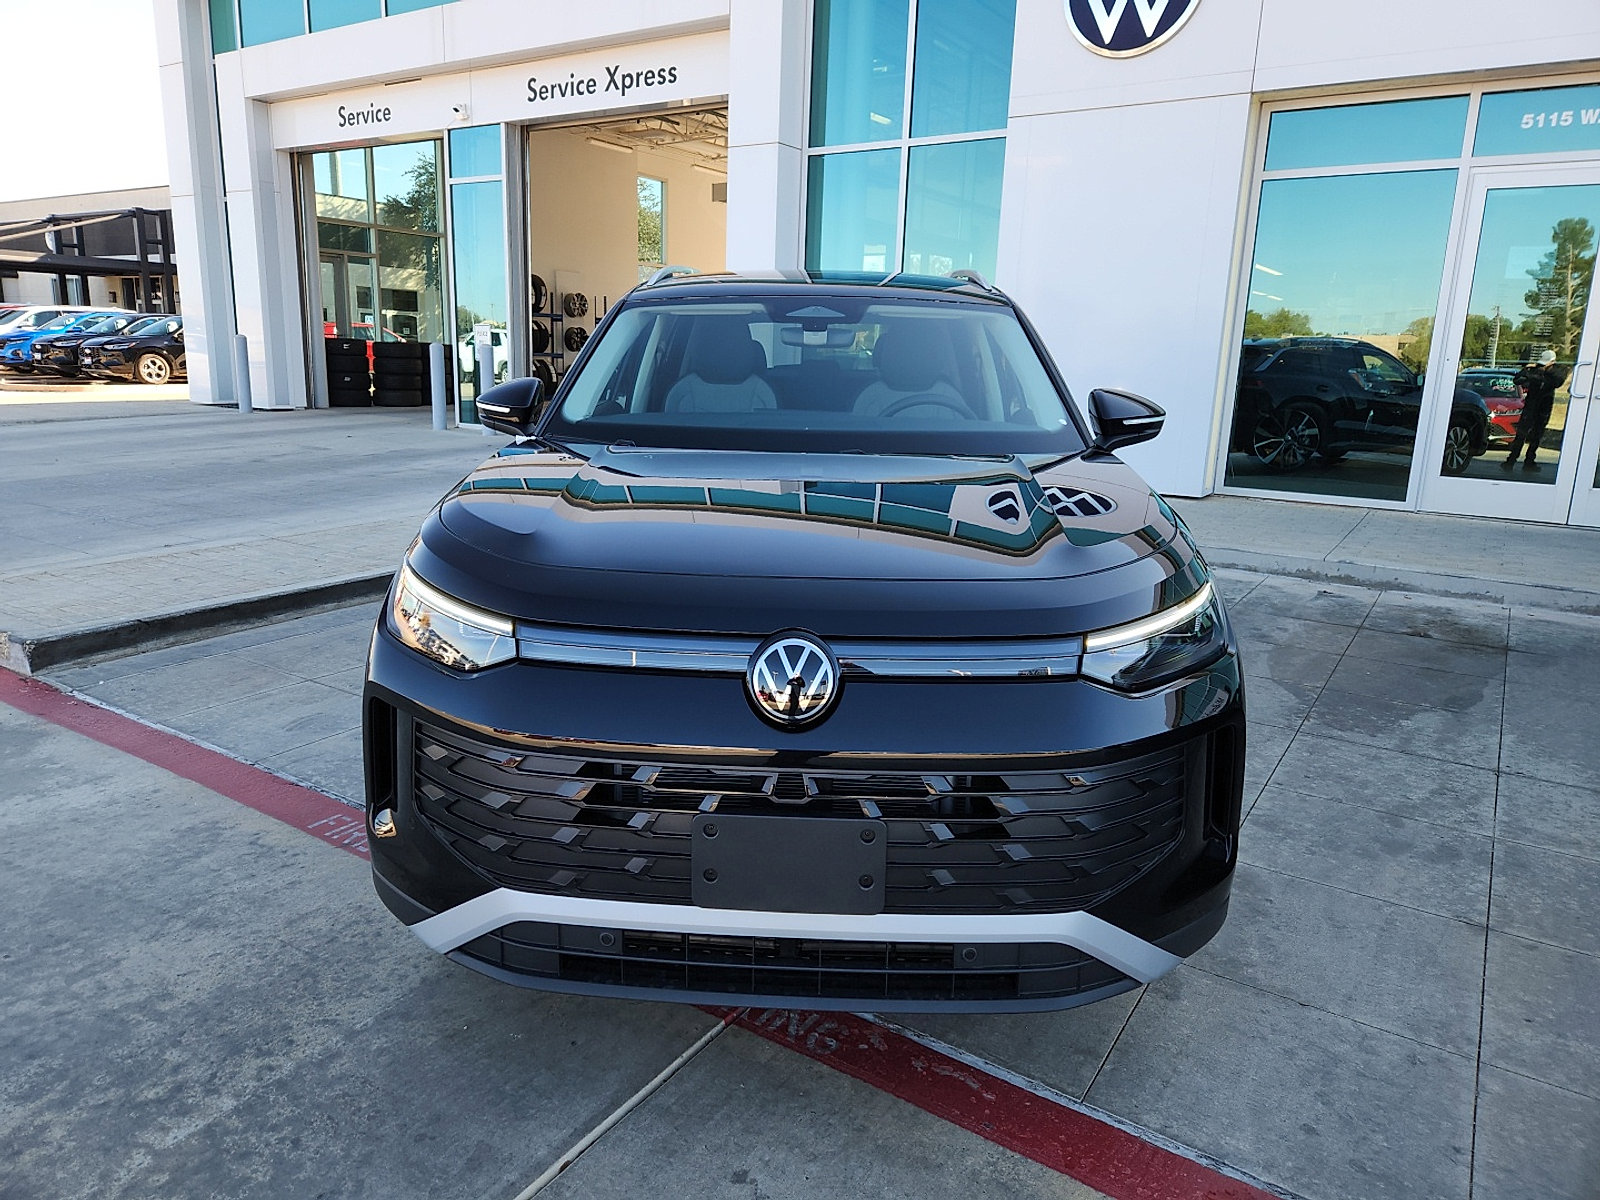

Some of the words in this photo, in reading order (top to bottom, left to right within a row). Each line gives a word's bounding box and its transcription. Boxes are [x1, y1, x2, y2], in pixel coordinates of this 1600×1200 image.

[527, 73, 597, 103] Service
[604, 64, 678, 97] Xpress
[337, 102, 392, 128] Service
[1520, 110, 1574, 129] 5115
[1580, 108, 1600, 125] W
[755, 640, 831, 715] VW
